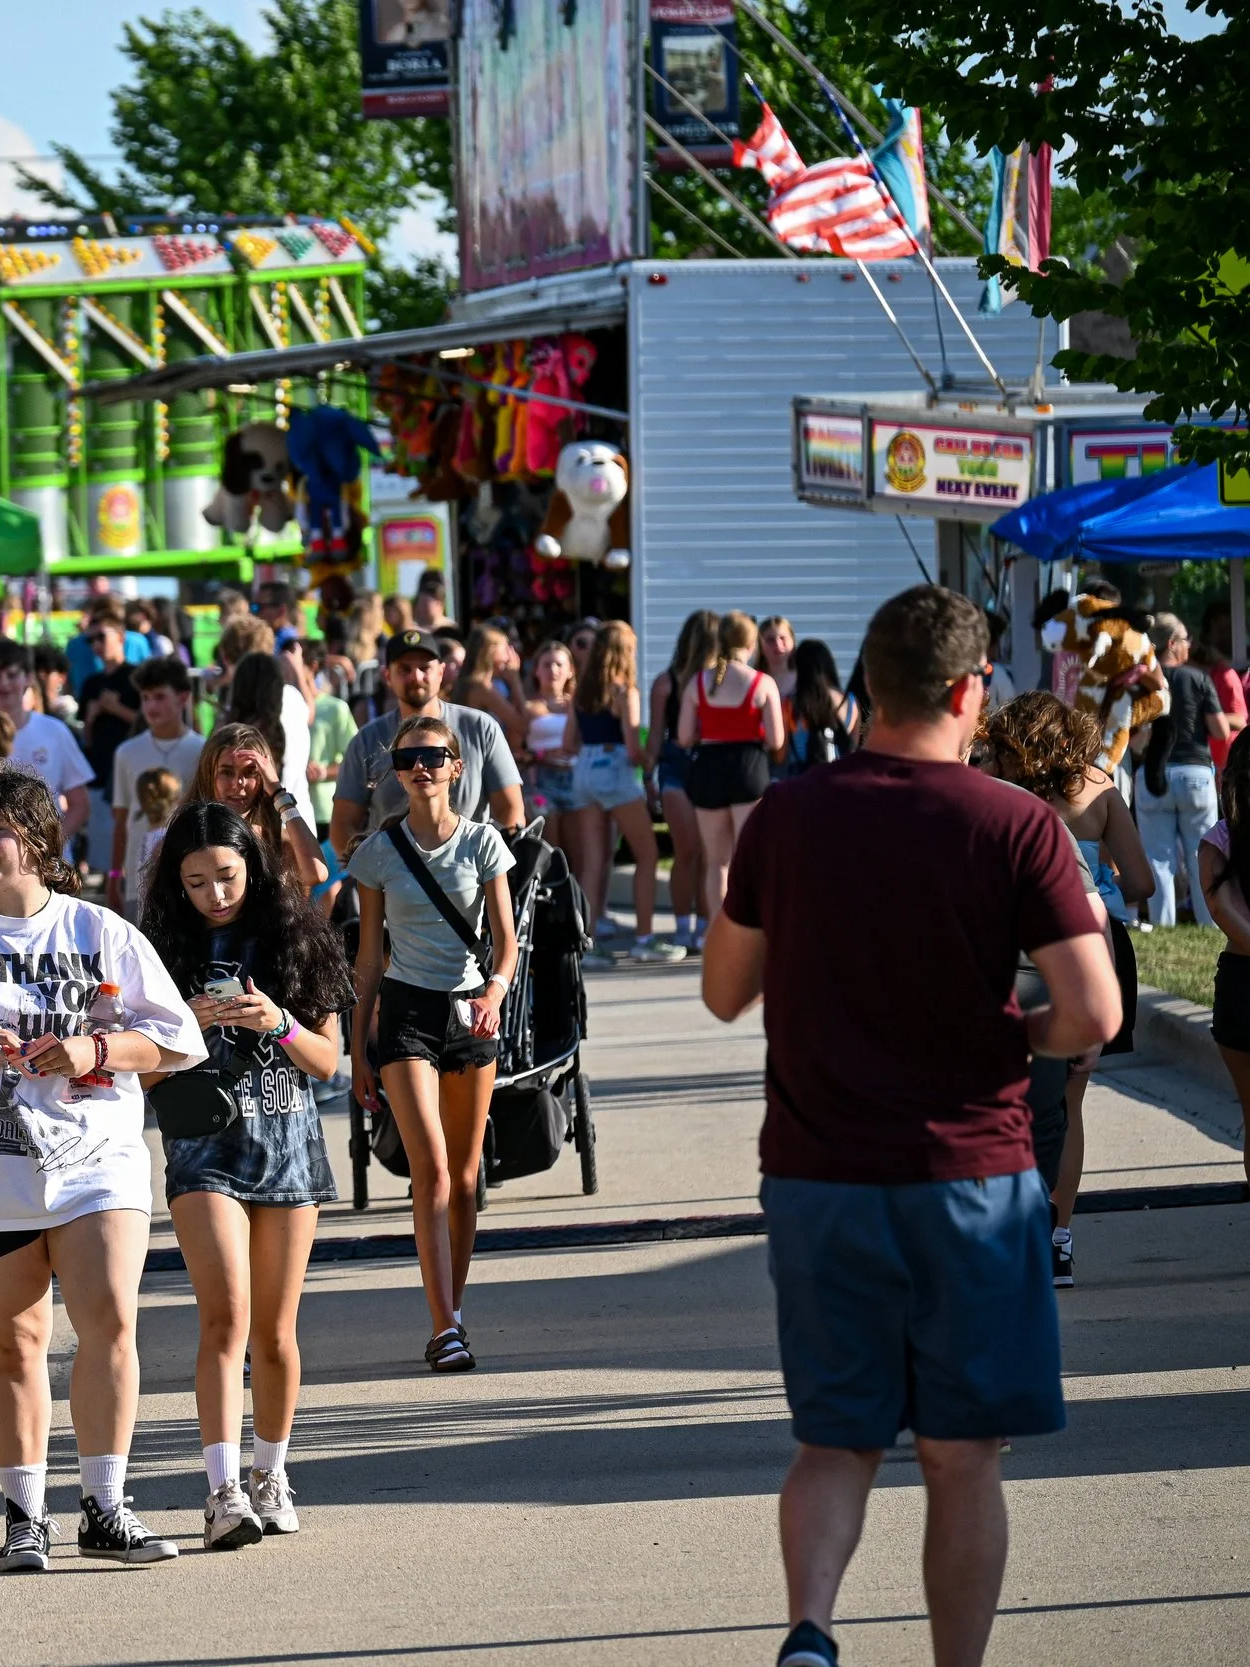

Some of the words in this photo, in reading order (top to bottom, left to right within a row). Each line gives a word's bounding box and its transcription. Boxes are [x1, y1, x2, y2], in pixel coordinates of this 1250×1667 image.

[934, 436, 968, 455] CALL
[993, 441, 1023, 460] FOR
[936, 477, 972, 496] NEXT
[974, 481, 1018, 500] EVENT
[261, 1067, 304, 1116] SOX
